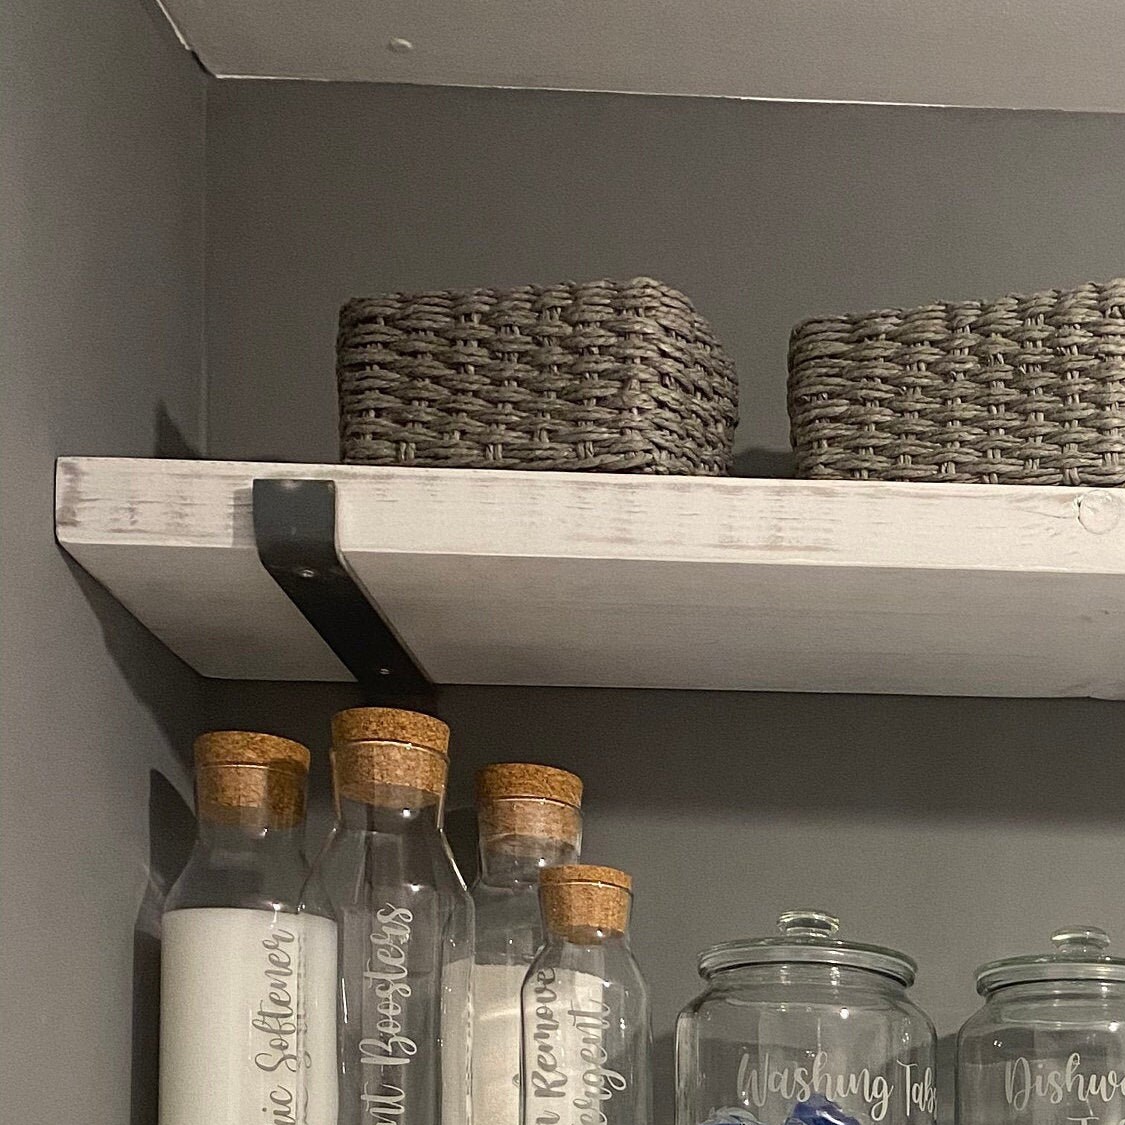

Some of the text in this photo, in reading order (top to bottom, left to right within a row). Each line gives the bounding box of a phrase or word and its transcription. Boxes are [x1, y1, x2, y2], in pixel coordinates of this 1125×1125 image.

[252, 928, 312, 1074] Softener
[359, 902, 417, 1066] Boosters
[737, 1050, 895, 1121] Washing
